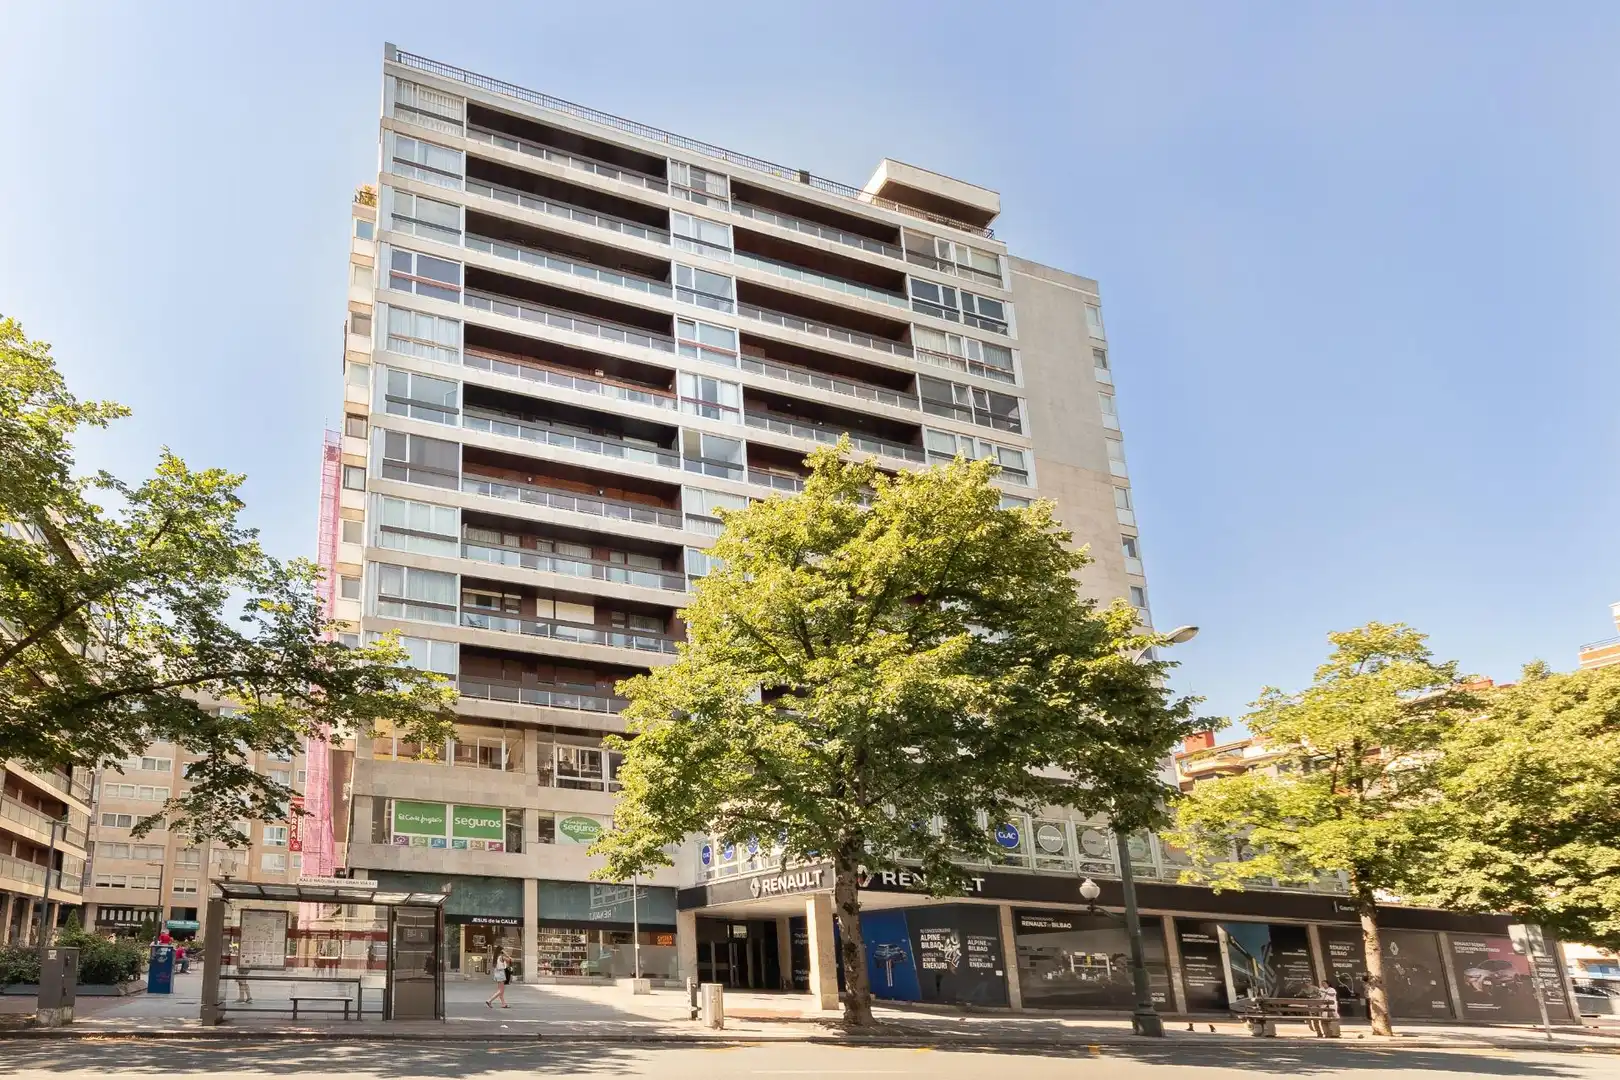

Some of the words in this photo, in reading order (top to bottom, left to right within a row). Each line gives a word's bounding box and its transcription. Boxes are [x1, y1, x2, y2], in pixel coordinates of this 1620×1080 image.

[454, 816, 501, 829] seguros
[762, 869, 823, 893] RENAULT
[881, 871, 986, 892] RENLT
[1021, 920, 1047, 928] RENAULT
[920, 933, 940, 941] ALPINE
[921, 941, 941, 949] BILBAO
